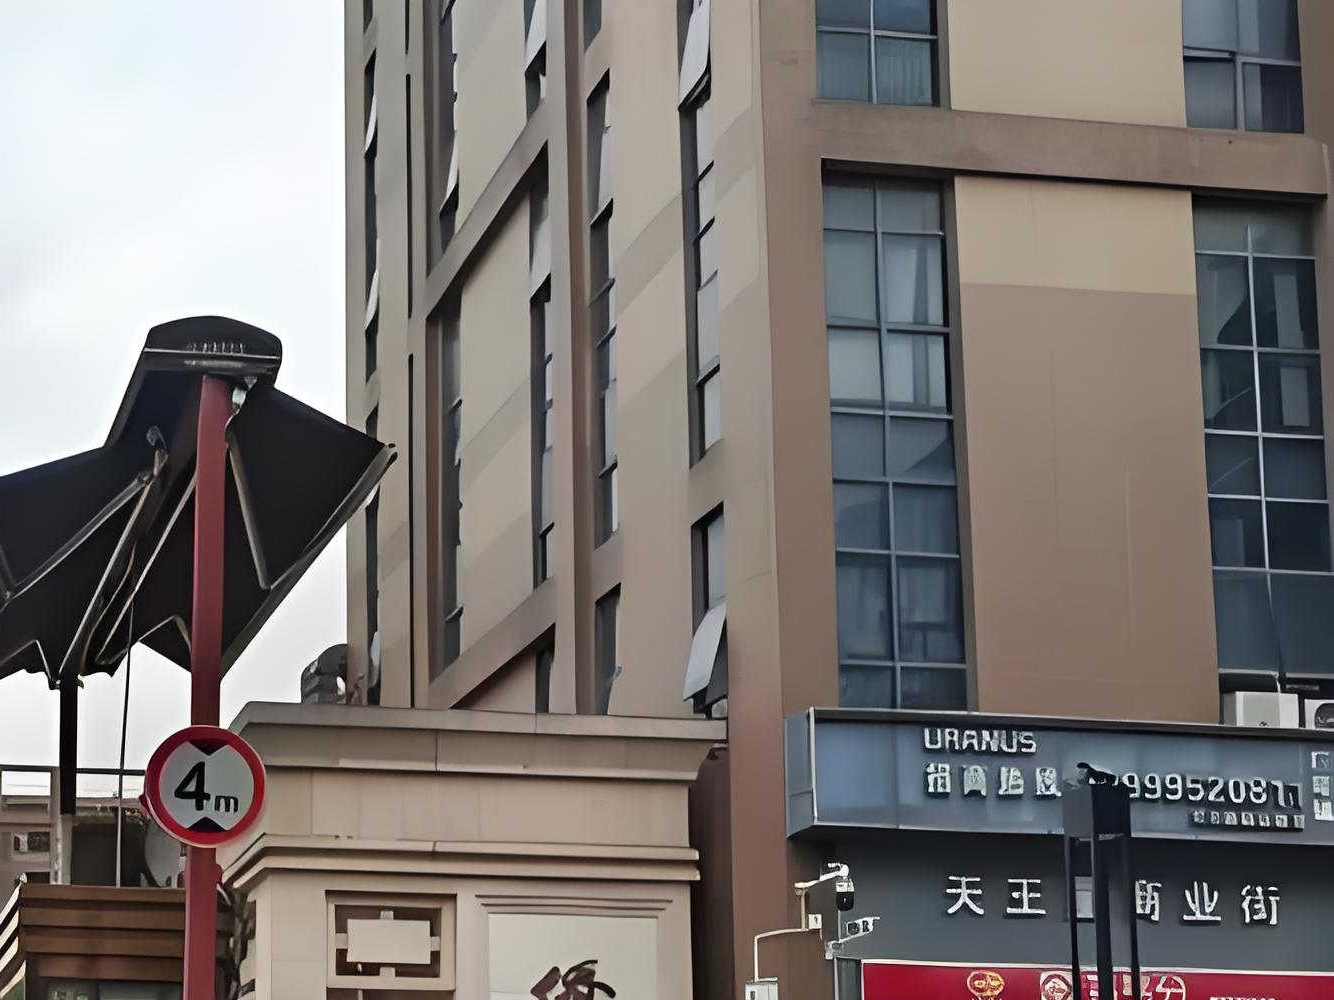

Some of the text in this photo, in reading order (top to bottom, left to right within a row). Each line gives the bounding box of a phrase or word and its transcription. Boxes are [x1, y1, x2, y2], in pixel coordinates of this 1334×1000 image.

[923, 727, 1037, 753] URANUS
[945, 876, 1280, 925] 天王商业街
